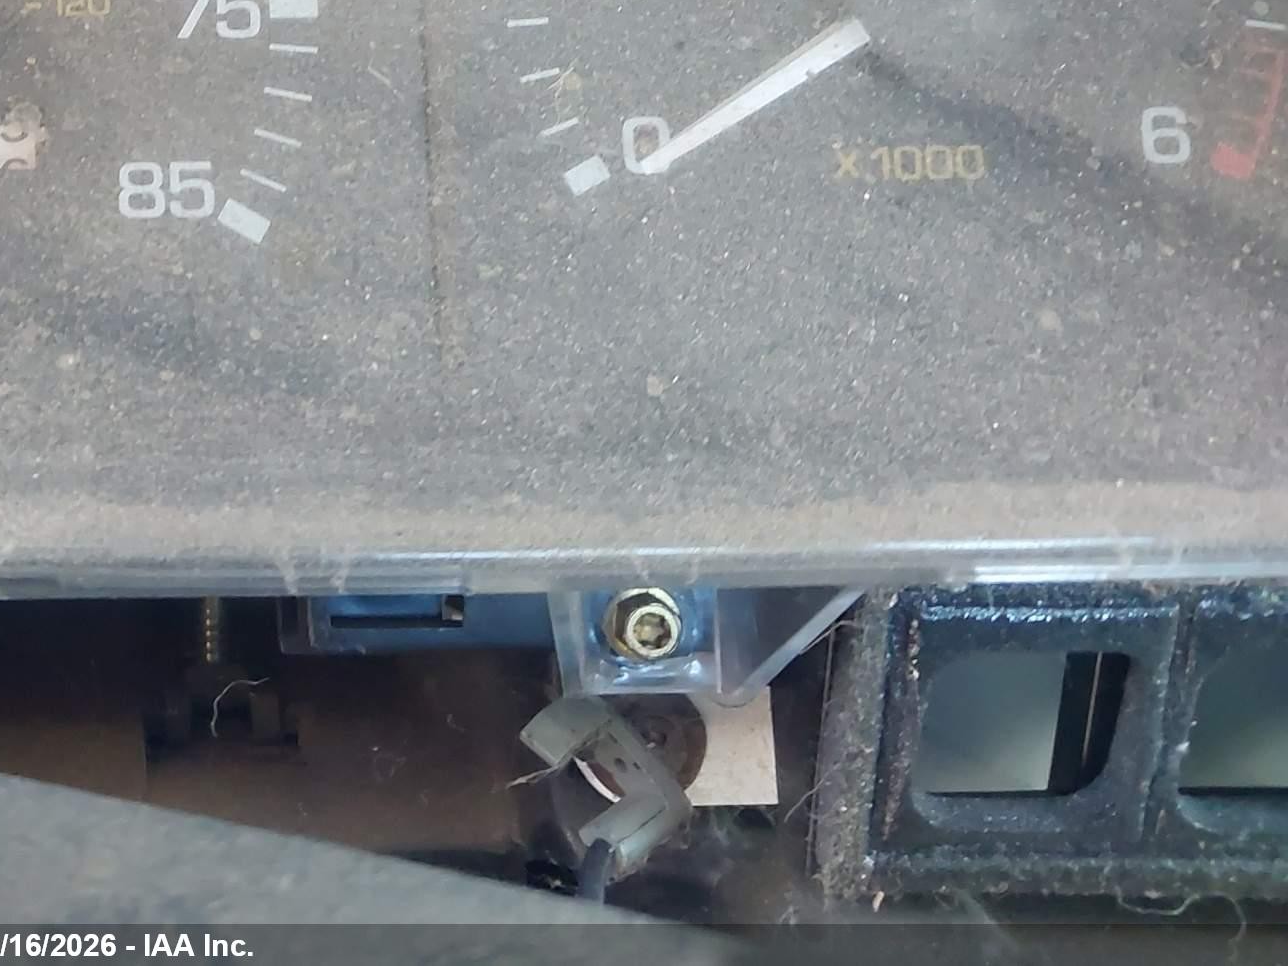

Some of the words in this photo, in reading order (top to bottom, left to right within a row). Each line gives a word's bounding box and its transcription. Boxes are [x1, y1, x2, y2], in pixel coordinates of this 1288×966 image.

[621, 116, 672, 174] 0
[1140, 106, 1192, 165] 6
[118, 161, 214, 219] 85
